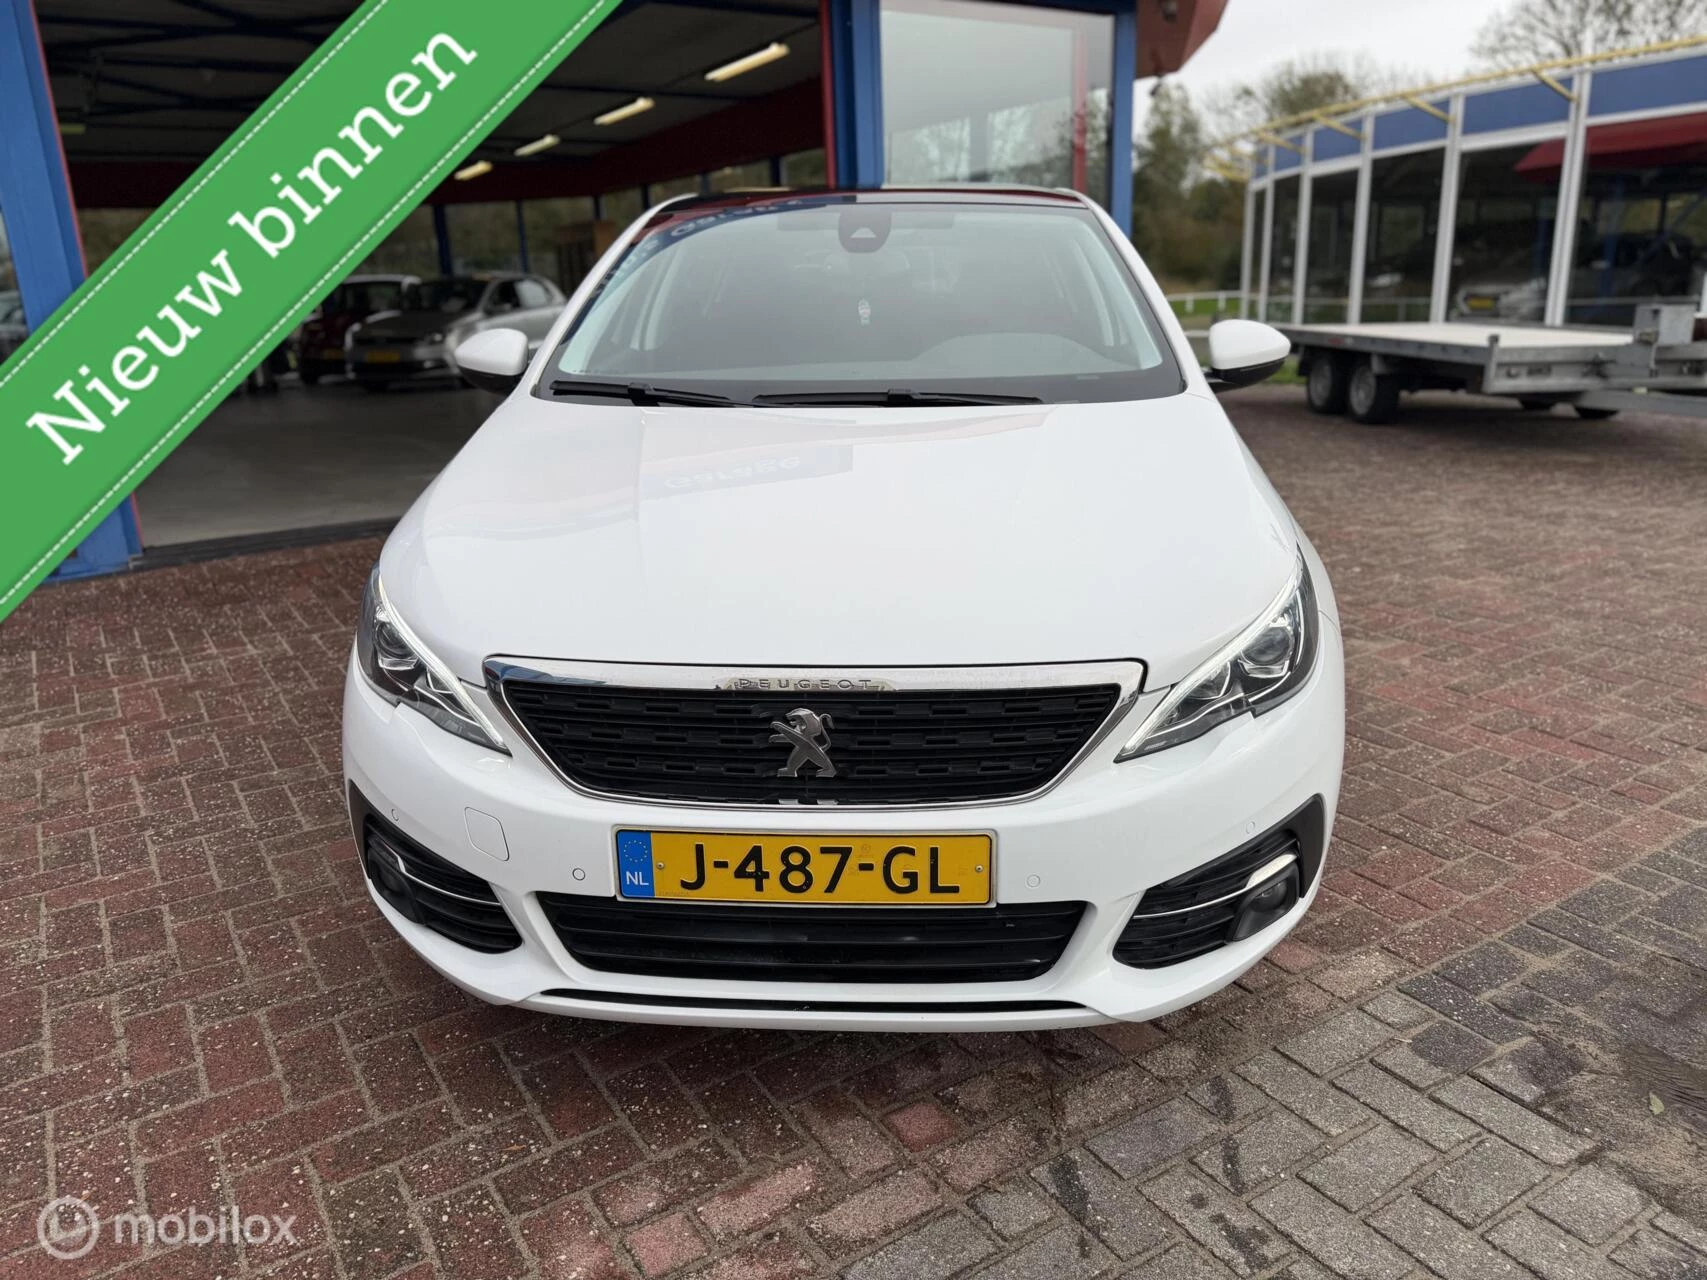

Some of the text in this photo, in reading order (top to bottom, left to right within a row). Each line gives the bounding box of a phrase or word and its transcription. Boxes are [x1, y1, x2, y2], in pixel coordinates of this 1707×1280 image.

[738, 678, 873, 690] PEUGEOT
[680, 842, 960, 895] J-487-GL
[626, 870, 649, 886] NL
